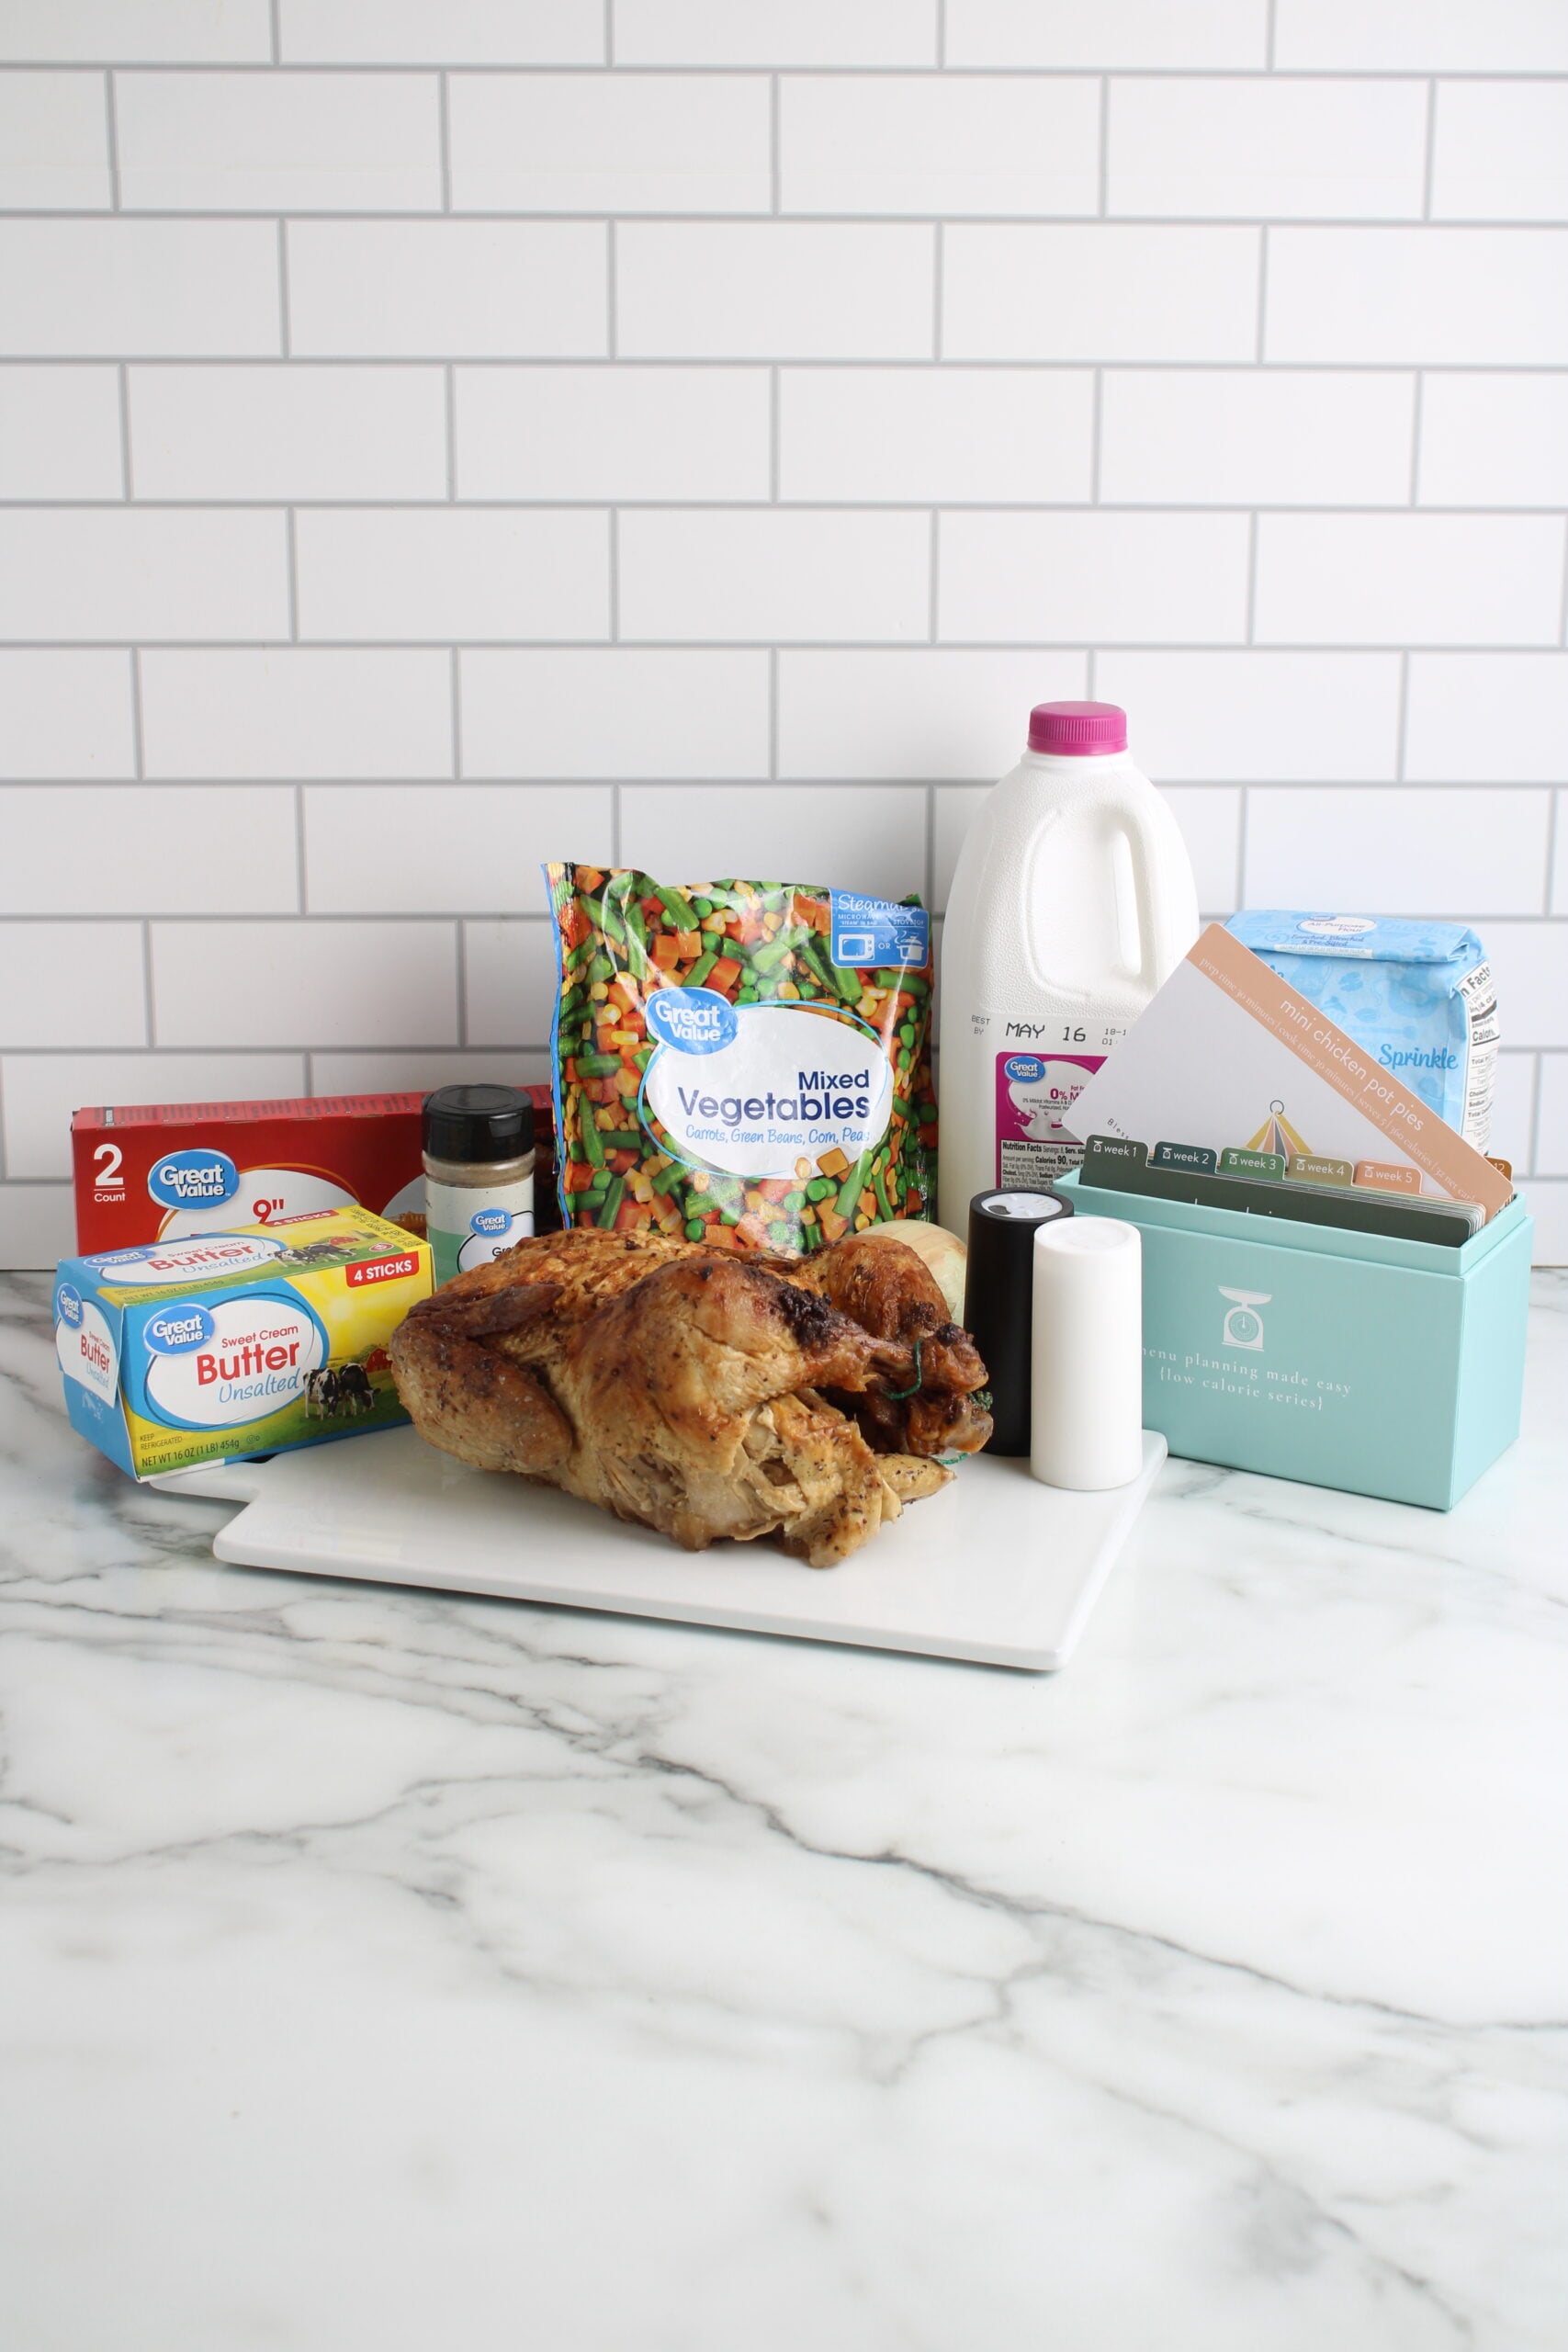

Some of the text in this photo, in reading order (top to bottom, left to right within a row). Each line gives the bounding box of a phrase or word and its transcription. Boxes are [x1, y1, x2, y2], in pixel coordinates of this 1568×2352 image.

[1219, 971, 1236, 991] time
[655, 1000, 720, 1027] Great
[971, 1015, 991, 1026] BEST
[670, 1023, 721, 1042] Value
[974, 1027, 985, 1035] BY
[1005, 1023, 1086, 1042] MAY 16
[1280, 1000, 1425, 1132] mini chicken pot pies
[1378, 1043, 1459, 1070] Sprinkle
[1010, 1061, 1039, 1073] Great
[798, 1069, 870, 1091] Mixed
[1050, 1088, 1068, 1101] 0%
[678, 1087, 871, 1126] Vegetables
[685, 1124, 870, 1145] Carrots, Green Beans, Corn, Peas
[1002, 1141, 1025, 1151] Nutrition
[1026, 1143, 1042, 1152] Facts
[1104, 1144, 1137, 1158] week 1
[94, 1143, 124, 1186] 2
[1035, 1156, 1056, 1165] Calories
[1173, 1150, 1210, 1165] week 2
[1240, 1157, 1277, 1170] week 3
[159, 1164, 225, 1186] Great
[1307, 1162, 1345, 1177] week 4
[1375, 1169, 1413, 1183] week 5
[94, 1193, 126, 1203] Count
[175, 1184, 225, 1198] Value
[282, 1212, 333, 1225] STICKS
[475, 1215, 505, 1226] Great
[482, 1223, 506, 1231] Value
[204, 1240, 245, 1253] Cream
[148, 1245, 254, 1270] Butter
[182, 1252, 266, 1273] Unsalted
[354, 1260, 412, 1282] 4 STICKS
[60, 1290, 80, 1311] Great
[152, 1314, 203, 1338] Great
[164, 1331, 204, 1346] Value
[221, 1325, 299, 1349] Sweet Cream
[80, 1333, 110, 1374] Butter
[197, 1341, 300, 1386] Butter
[1185, 1352, 1258, 1380] planning
[1266, 1369, 1309, 1386] made
[1316, 1379, 1352, 1397] easy
[219, 1367, 301, 1404] Unsalted
[1160, 1366, 1323, 1411] {low calorie series}
[140, 1433, 154, 1442] KEEP
[140, 1435, 183, 1451] REFRIGERATED
[141, 1455, 157, 1467] NET
[158, 1452, 172, 1464] WT
[174, 1450, 183, 1460] 16
[185, 1447, 195, 1457] OZ
[196, 1444, 204, 1456] (1
[205, 1442, 220, 1454] LB)
[220, 1439, 240, 1453] 454g
